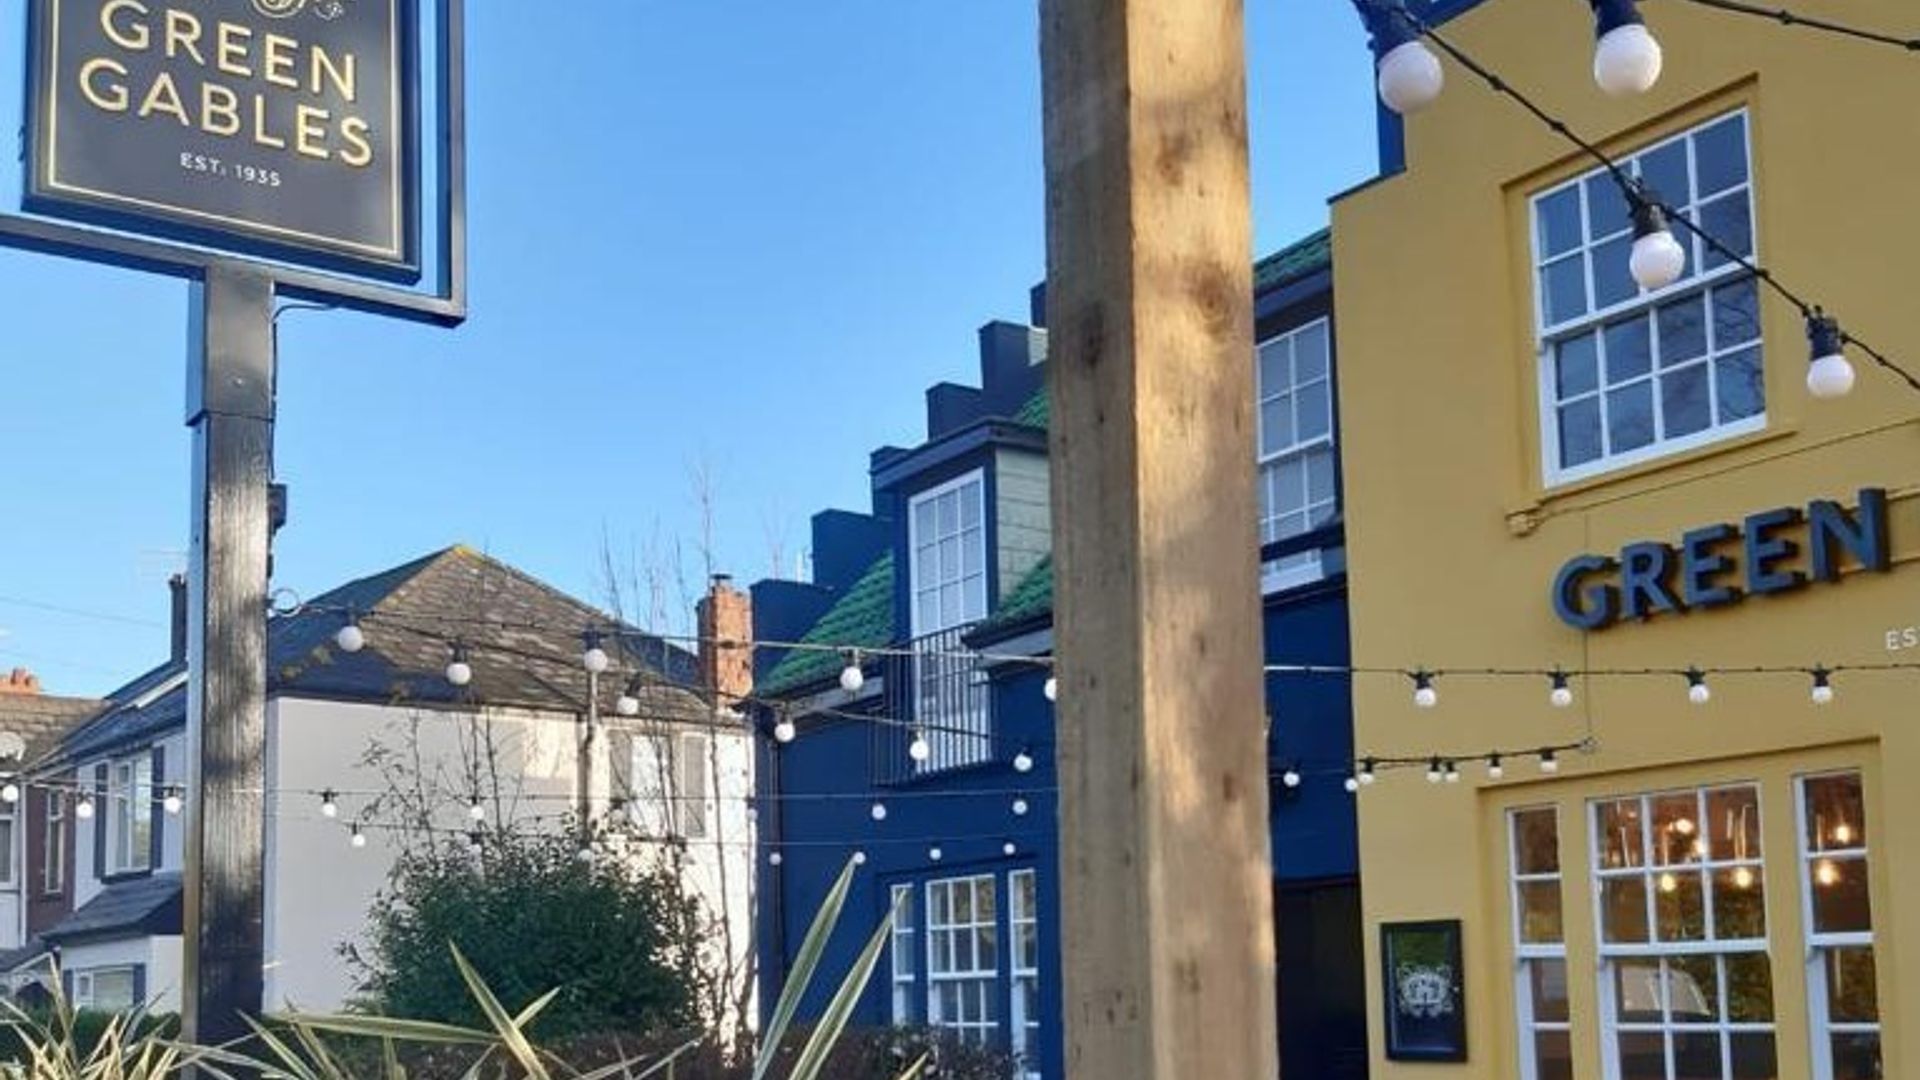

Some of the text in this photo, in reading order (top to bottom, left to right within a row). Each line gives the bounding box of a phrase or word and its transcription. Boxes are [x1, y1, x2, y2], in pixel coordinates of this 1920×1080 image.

[100, 0, 357, 101] GREEN
[79, 58, 373, 167] GABLES
[235, 164, 281, 187] 1935
[1552, 487, 1888, 630] GREEN
[1885, 627, 1920, 650] ES
